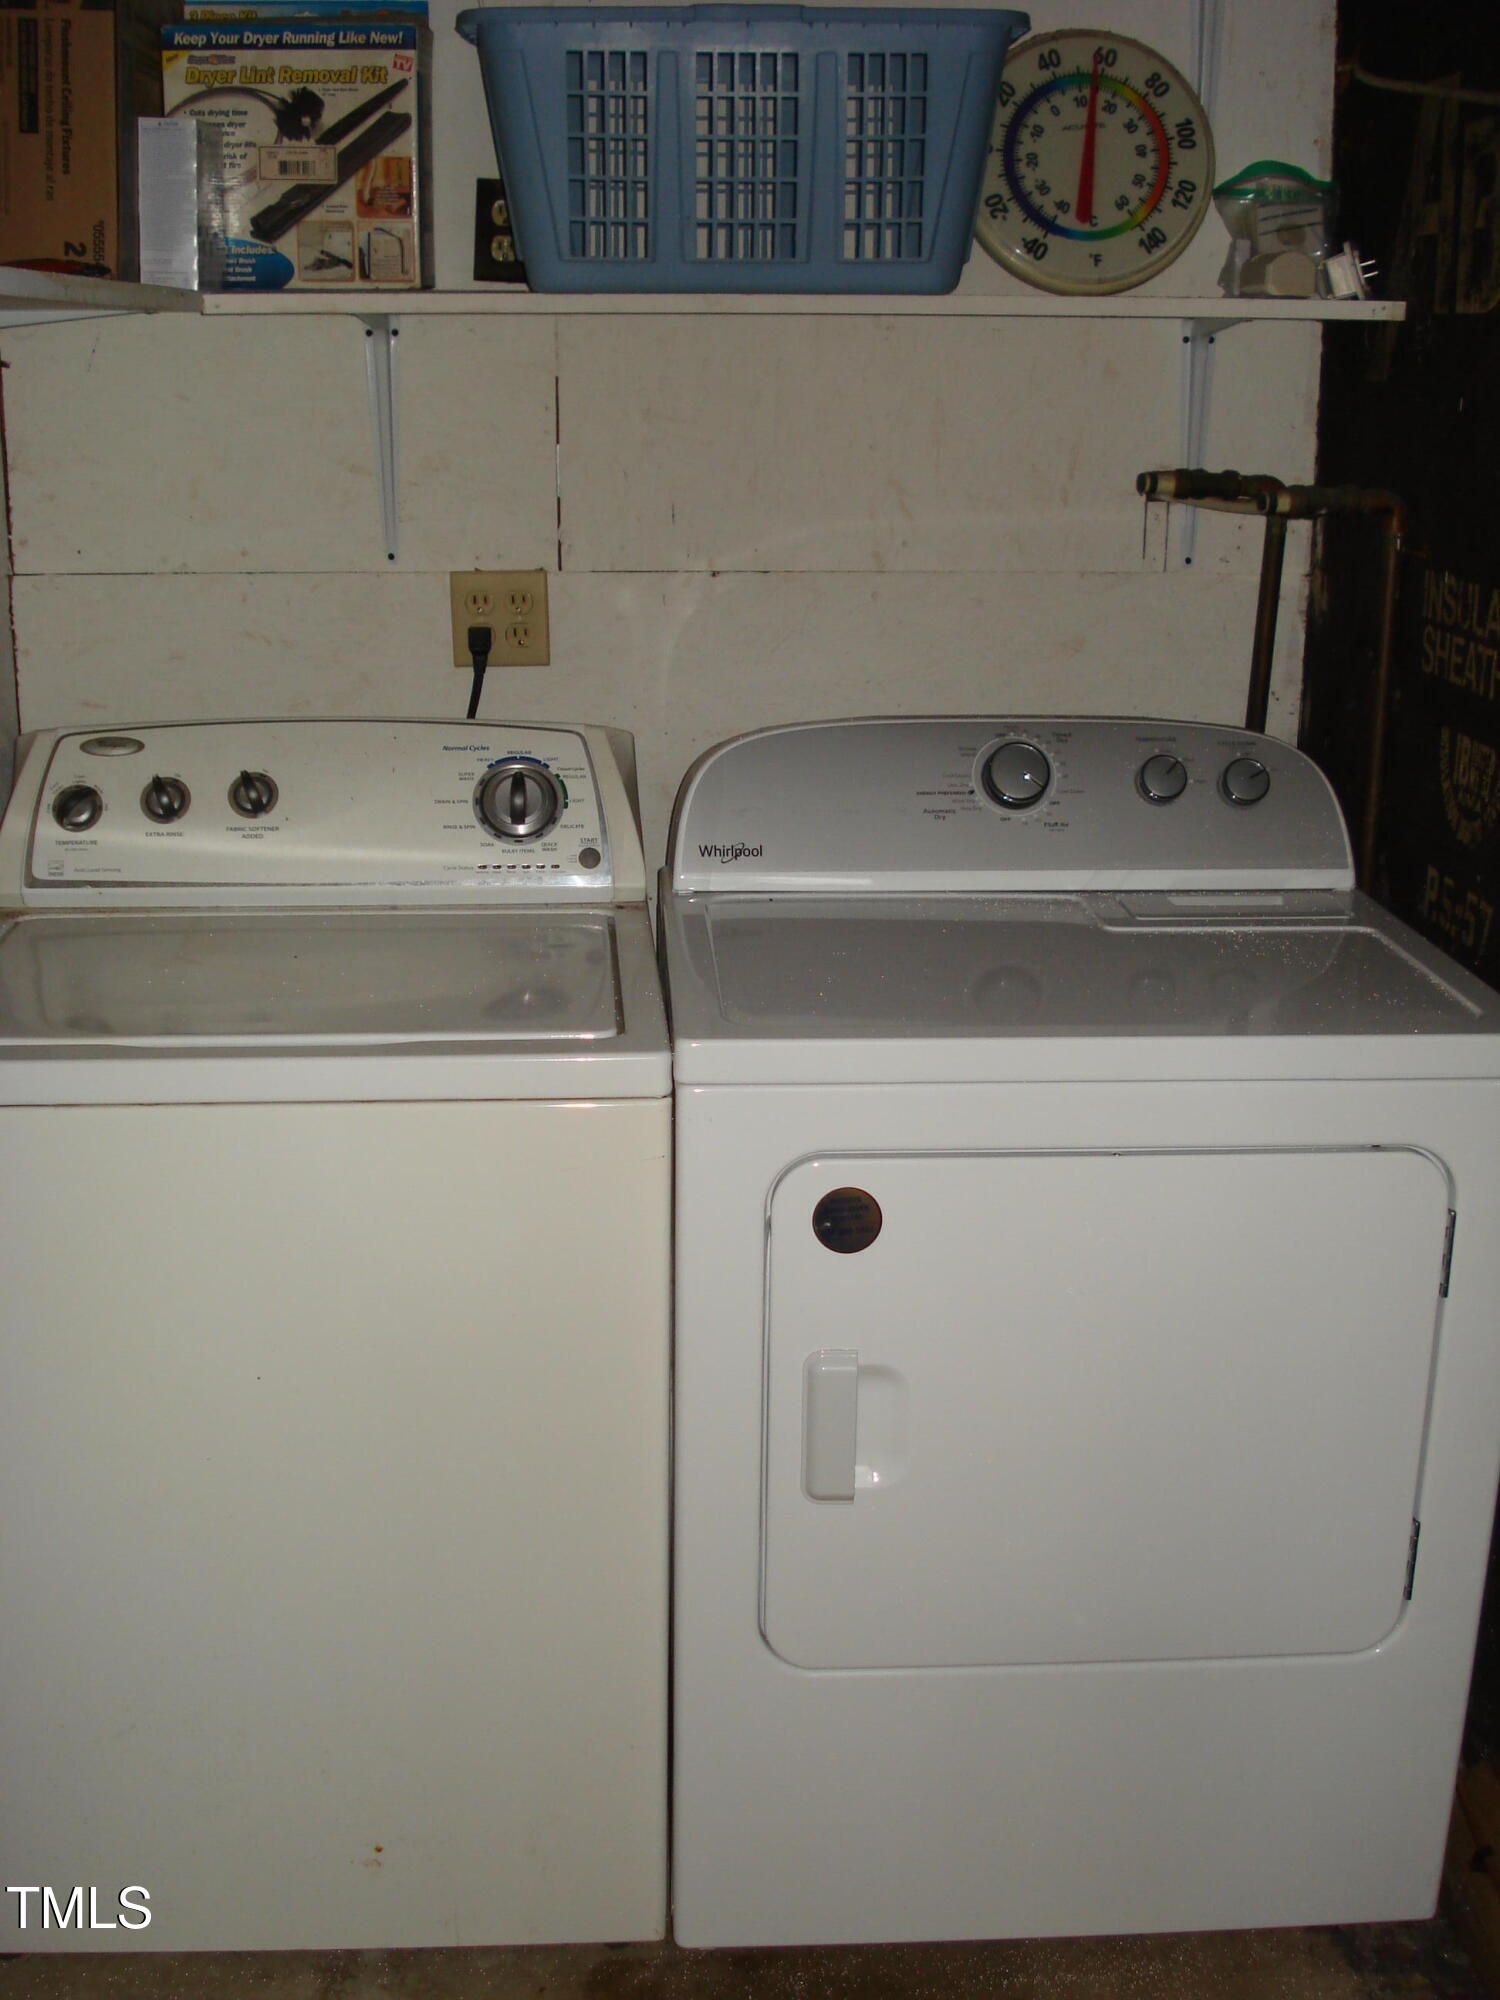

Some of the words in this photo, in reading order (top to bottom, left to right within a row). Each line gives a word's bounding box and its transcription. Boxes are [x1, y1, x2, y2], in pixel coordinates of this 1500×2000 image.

[174, 31, 207, 47] Keep
[210, 31, 240, 45] Your
[243, 31, 279, 47] Dryer
[282, 31, 335, 47] Running
[338, 31, 366, 45] Like
[369, 31, 404, 45] New!
[1038, 49, 1061, 70] 40
[1093, 46, 1117, 68] 60
[185, 66, 238, 88] Dryer
[240, 65, 275, 84] Lint
[278, 65, 358, 85] Removal
[360, 66, 388, 84] Kit
[1144, 72, 1170, 97] 80
[999, 81, 1016, 108] 20
[1073, 95, 1088, 108] 10
[1050, 103, 1061, 117] 0
[1101, 100, 1118, 115] 20
[1122, 118, 1138, 134] 30
[1175, 117, 1197, 150] 100
[1130, 173, 1147, 189] 50
[1170, 179, 1197, 210] 120
[63, 240, 87, 257] 2
[1021, 237, 1048, 261] -40
[1138, 226, 1168, 254] 140
[698, 843, 763, 862] Whirlpool
